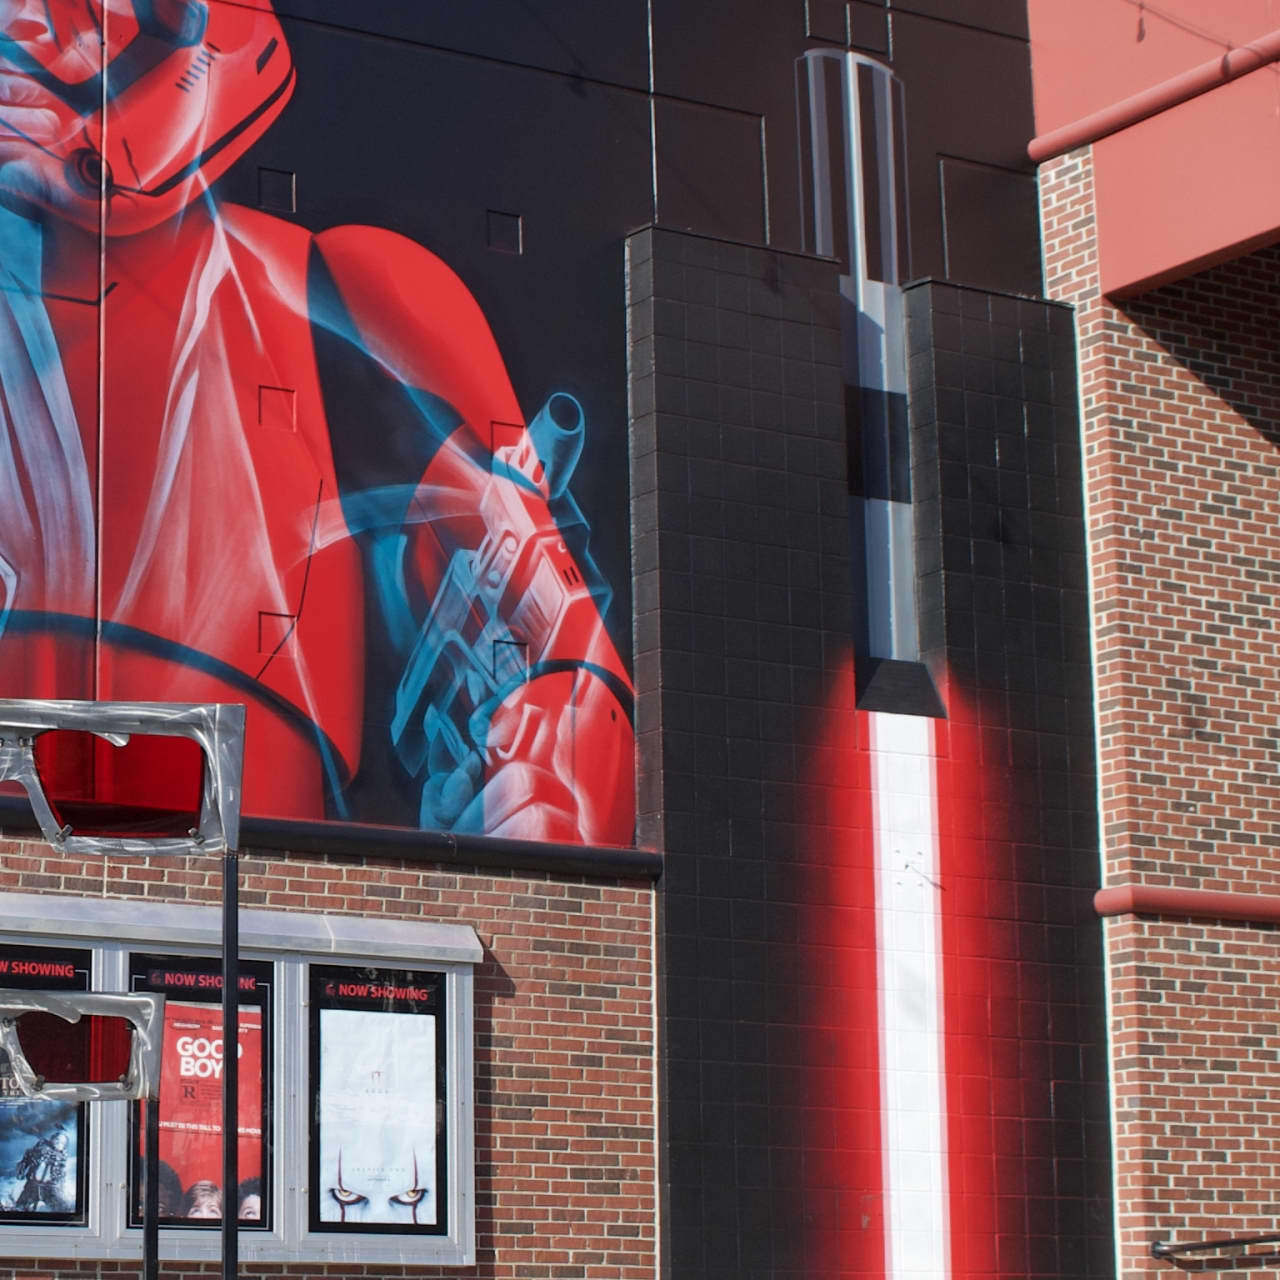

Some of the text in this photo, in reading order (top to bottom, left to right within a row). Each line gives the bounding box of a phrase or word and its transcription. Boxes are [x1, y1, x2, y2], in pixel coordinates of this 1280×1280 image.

[11, 961, 75, 978] SHOWING
[164, 972, 257, 990] NOW SHOING
[338, 983, 429, 1001] NOW SHOWING
[180, 1057, 223, 1079] BOY
